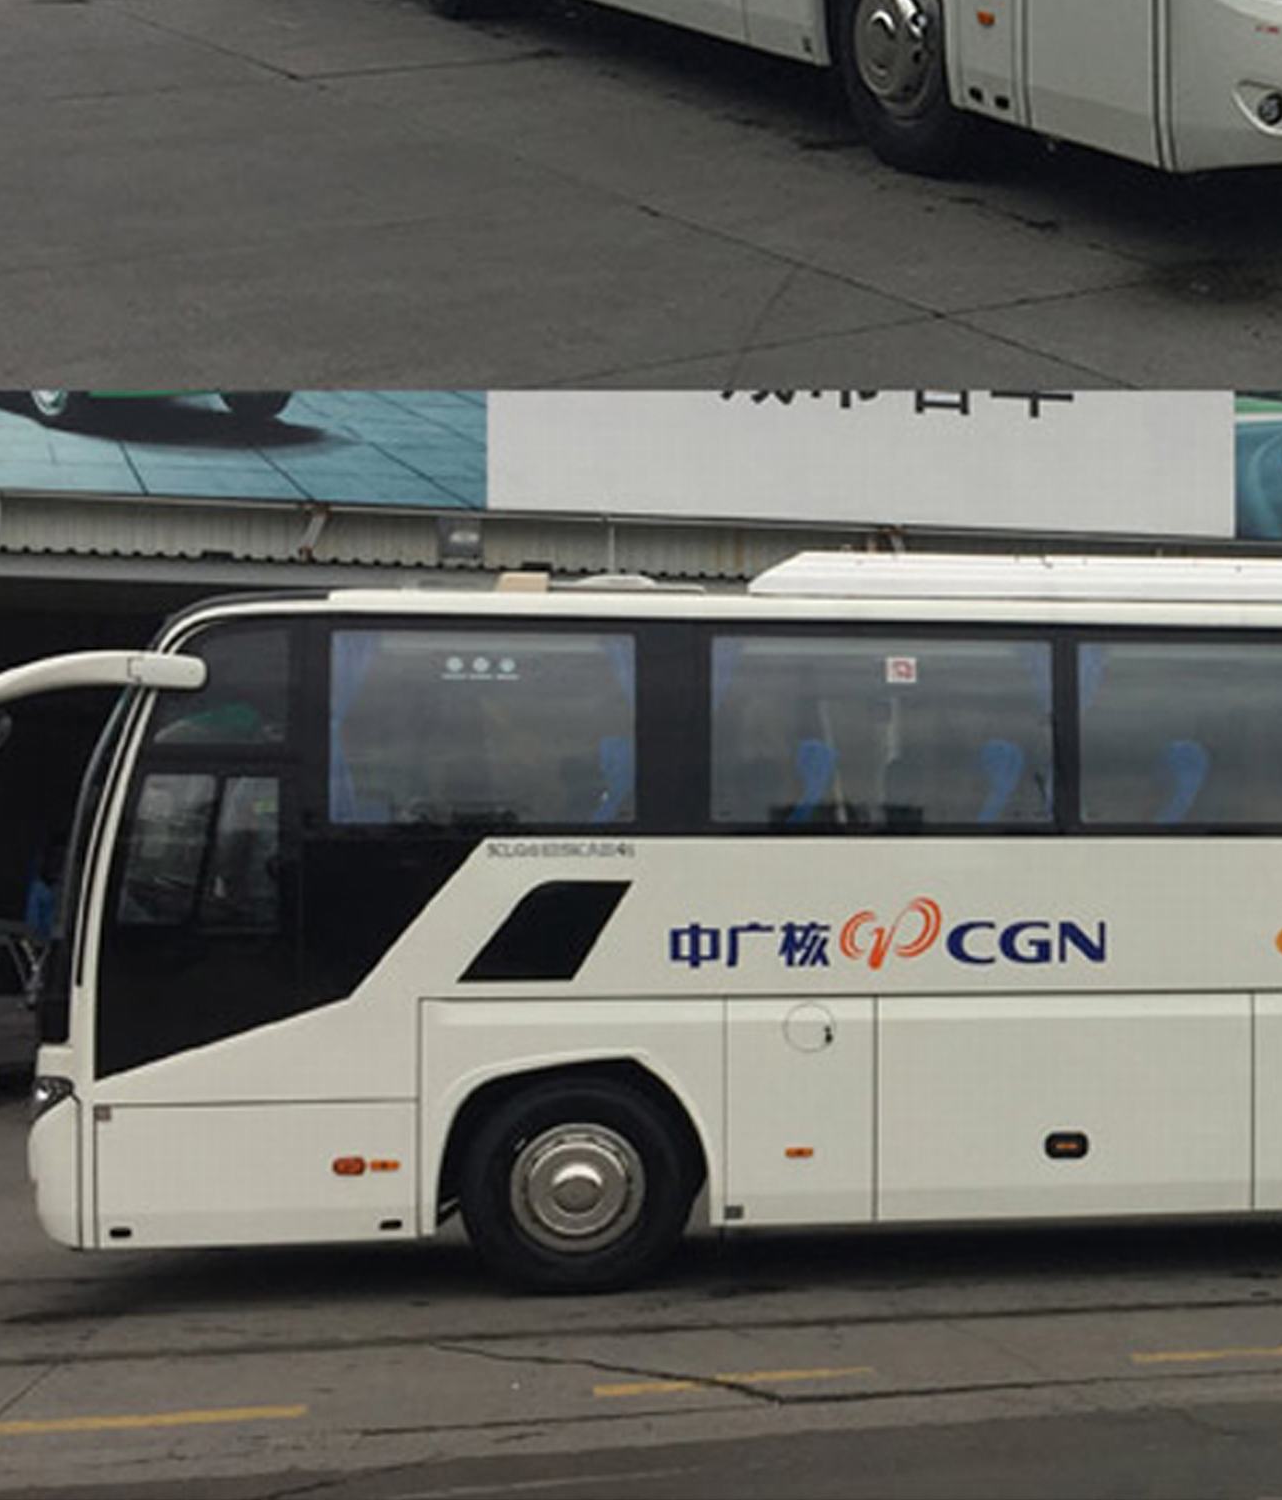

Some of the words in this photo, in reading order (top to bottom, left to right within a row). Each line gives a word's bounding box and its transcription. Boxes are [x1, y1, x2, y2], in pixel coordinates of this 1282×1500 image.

[668, 922, 831, 968] 中广核
[946, 921, 1106, 964] CGN
